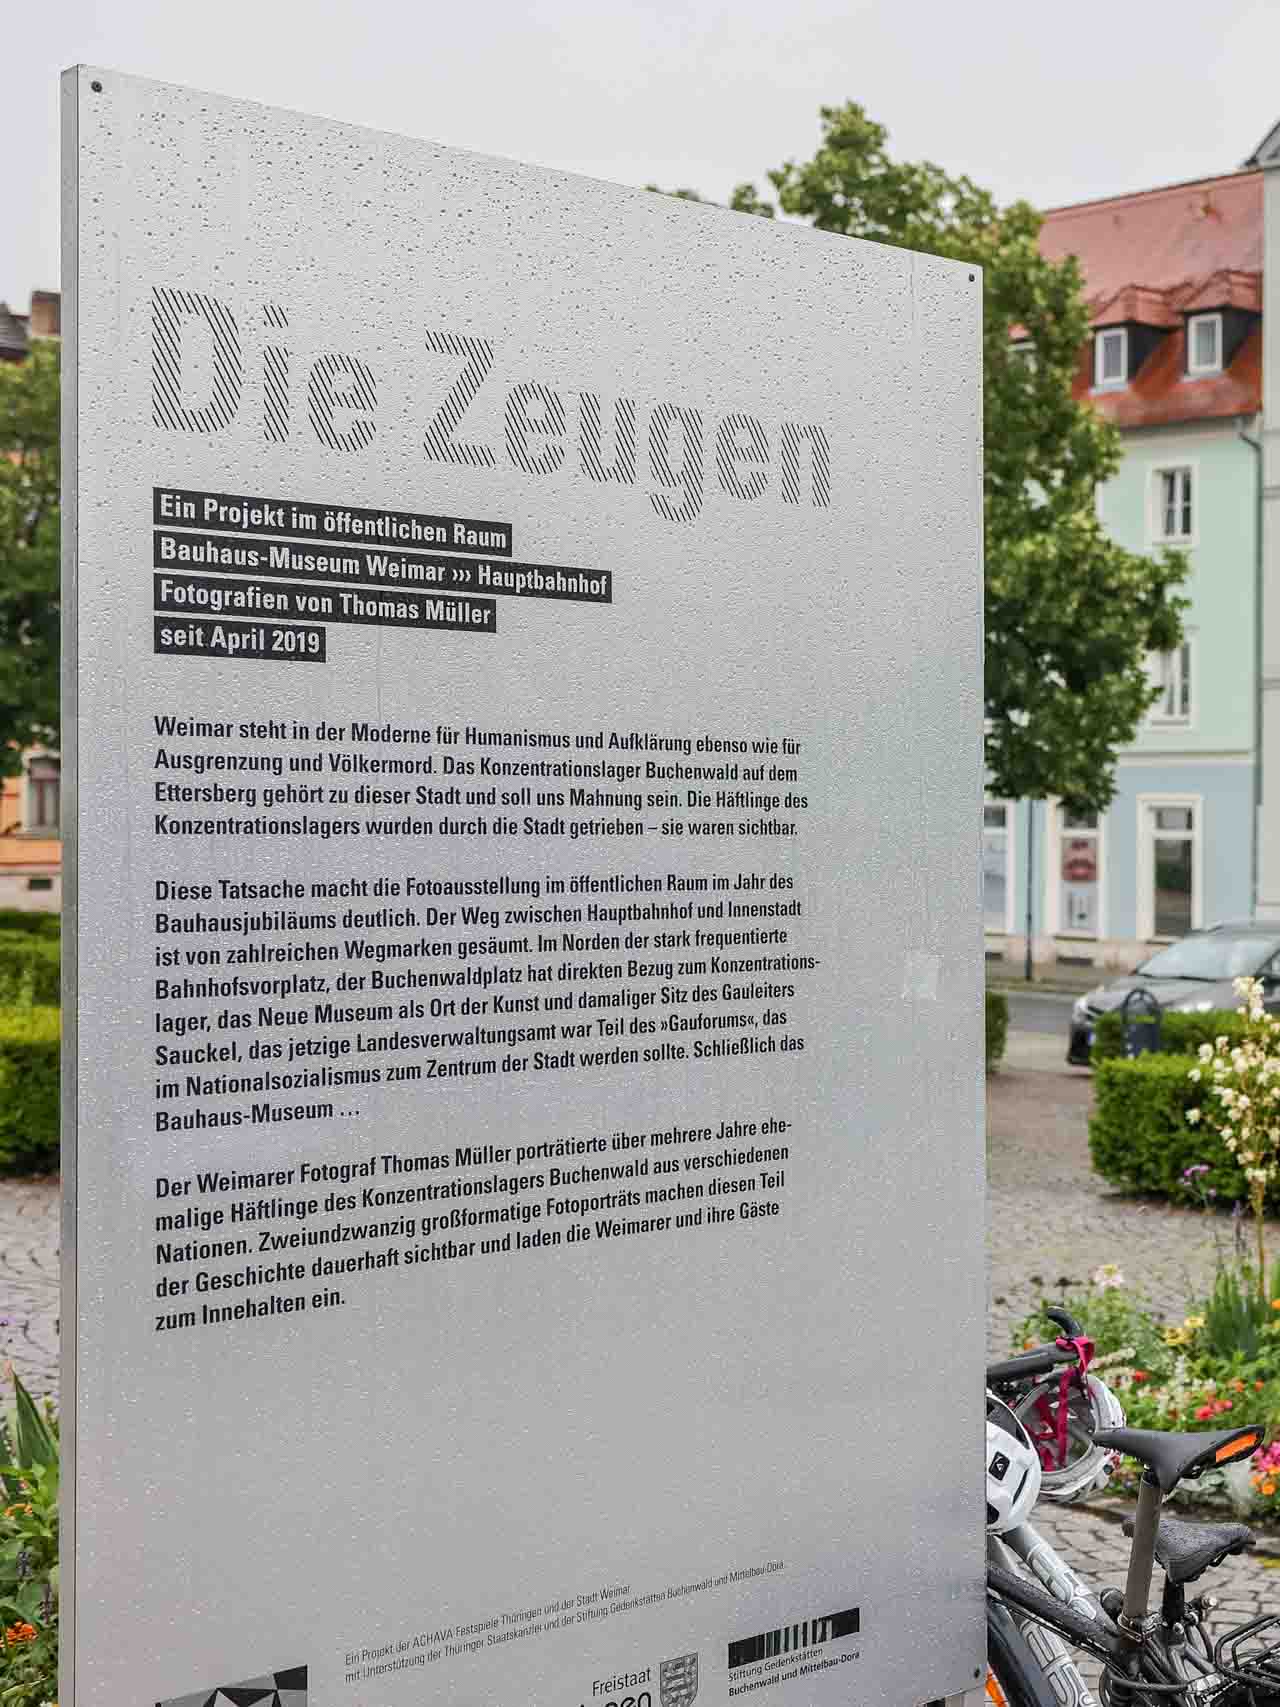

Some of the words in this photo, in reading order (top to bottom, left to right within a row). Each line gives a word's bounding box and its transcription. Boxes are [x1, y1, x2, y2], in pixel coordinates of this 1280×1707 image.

[151, 286, 377, 453] Die
[423, 329, 832, 523] Zeugen
[161, 494, 195, 519] Ein
[205, 499, 285, 529] Projekt
[292, 507, 316, 530] im
[324, 510, 446, 540] öffentlichen
[454, 523, 506, 549] Raum
[162, 537, 360, 574] Bauhaus-Museum
[367, 554, 446, 581] Weimar
[477, 565, 607, 597] Hauptbahnhof
[161, 580, 289, 610] Fotografien
[296, 596, 333, 613] von
[340, 594, 419, 618] Thomas
[426, 600, 491, 624] Müller
[161, 627, 204, 647] seit
[211, 626, 264, 655] April
[272, 630, 320, 652] 2019
[154, 716, 233, 737] Weimar
[240, 720, 286, 739] steht
[293, 721, 308, 739] in
[316, 722, 345, 741] der
[352, 723, 430, 743] Moderne
[436, 726, 459, 744] für
[466, 727, 570, 748] Humanismus
[576, 732, 603, 748] und
[608, 733, 691, 755] Aufklärung
[697, 736, 747, 752] ebenso
[752, 737, 777, 753] wie
[782, 738, 800, 754] für
[154, 749, 282, 775] Ausgrenzung
[290, 753, 322, 771] und
[329, 753, 436, 774] Völkermord.
[444, 756, 474, 774] Das
[481, 758, 640, 782] Konzentrationslager
[646, 762, 738, 780] Buchenwald
[743, 765, 764, 780] auf
[769, 765, 797, 781] dem
[156, 815, 360, 839] Konzentrationslagers
[366, 816, 432, 834] wurden
[439, 817, 486, 834] durch
[493, 817, 517, 835] die
[524, 817, 565, 835] Stadt
[570, 818, 643, 839] getrieben
[662, 819, 683, 835] sie
[688, 823, 734, 835] waren
[739, 819, 797, 835] sichtbar.
[156, 911, 336, 936] Bauhausjubiläums
[343, 908, 420, 928] deutlich.
[427, 908, 456, 925] Der
[462, 907, 499, 928] Weg
[505, 905, 581, 923] zwischen
[588, 902, 693, 925] Hauptbahnhof
[698, 902, 723, 918] und
[729, 900, 801, 917] Innenstadt
[156, 947, 180, 966] ist
[186, 951, 220, 965] von
[227, 942, 338, 963] zahlreichen
[345, 938, 451, 962] Wegmarken
[458, 937, 532, 959] gesäumt.
[538, 935, 557, 952] Im
[563, 933, 619, 951] Norden
[625, 932, 649, 949] der
[654, 930, 690, 948] stark
[695, 928, 787, 950] frequentierte
[156, 974, 329, 999] Bahnhofsvorplatz,
[337, 972, 366, 990] der
[372, 966, 522, 989] Buchenwaldplatz
[528, 965, 552, 981] hat
[558, 962, 622, 980] direkten
[628, 960, 673, 979] Bezug
[678, 962, 706, 975] zum
[712, 954, 820, 973] Konzentrations-
[156, 1041, 242, 1065] Sauckel,
[249, 1040, 282, 1059] das
[288, 1036, 350, 1061] jetzige
[357, 1025, 556, 1052] Landesverwaltungsamt
[561, 1025, 592, 1038] war
[597, 1018, 623, 1036] Teil
[630, 1017, 655, 1034] des
[661, 1013, 758, 1031] »Gauforums«,
[763, 1009, 786, 1025] das
[157, 1178, 191, 1198] Der
[197, 1170, 294, 1193] Weimarer
[301, 1157, 376, 1183] Fotograf
[381, 1155, 449, 1174] Thomas
[456, 1146, 511, 1166] Müller
[517, 1137, 606, 1165] porträtierte
[612, 1132, 646, 1150] über
[651, 1128, 711, 1146] mehrere
[716, 1122, 756, 1139] Jahre
[762, 1118, 791, 1134] ehe-
[156, 1208, 224, 1231] malige
[231, 1198, 318, 1222] Häftlinge
[325, 1193, 356, 1212] des
[363, 1175, 544, 1207] Konzentrationslagers
[550, 1158, 648, 1186] Buchenwald
[654, 1160, 679, 1174] aus
[684, 1147, 788, 1170] verschiedenen
[157, 1240, 252, 1264] Nationen.
[259, 1216, 415, 1251] Zweiundzwanzig
[422, 1202, 541, 1235] großformatige
[547, 1190, 640, 1216] Fotoporträts
[646, 1183, 703, 1203] machen
[709, 1178, 755, 1195] diesen
[760, 1171, 784, 1188] Teil
[157, 1277, 189, 1297] der
[196, 1263, 305, 1292] Geschichte
[312, 1248, 399, 1276] dauerhaft
[404, 1241, 475, 1264] sichtbar
[481, 1233, 510, 1254] und
[517, 1229, 560, 1249] laden
[567, 1224, 590, 1242] die
[595, 1217, 671, 1238] Weimarer
[676, 1208, 701, 1228] und
[708, 1207, 734, 1223] ihre
[740, 1202, 779, 1219] Gäste
[592, 1667, 651, 1697] Freistaat
[729, 1667, 763, 1682] Stiftung
[765, 1648, 823, 1671] Gedenkstätten
[729, 1673, 780, 1697] Buchenwald
[782, 1670, 798, 1683] und
[800, 1652, 860, 1676] Mittelbau-Dora
